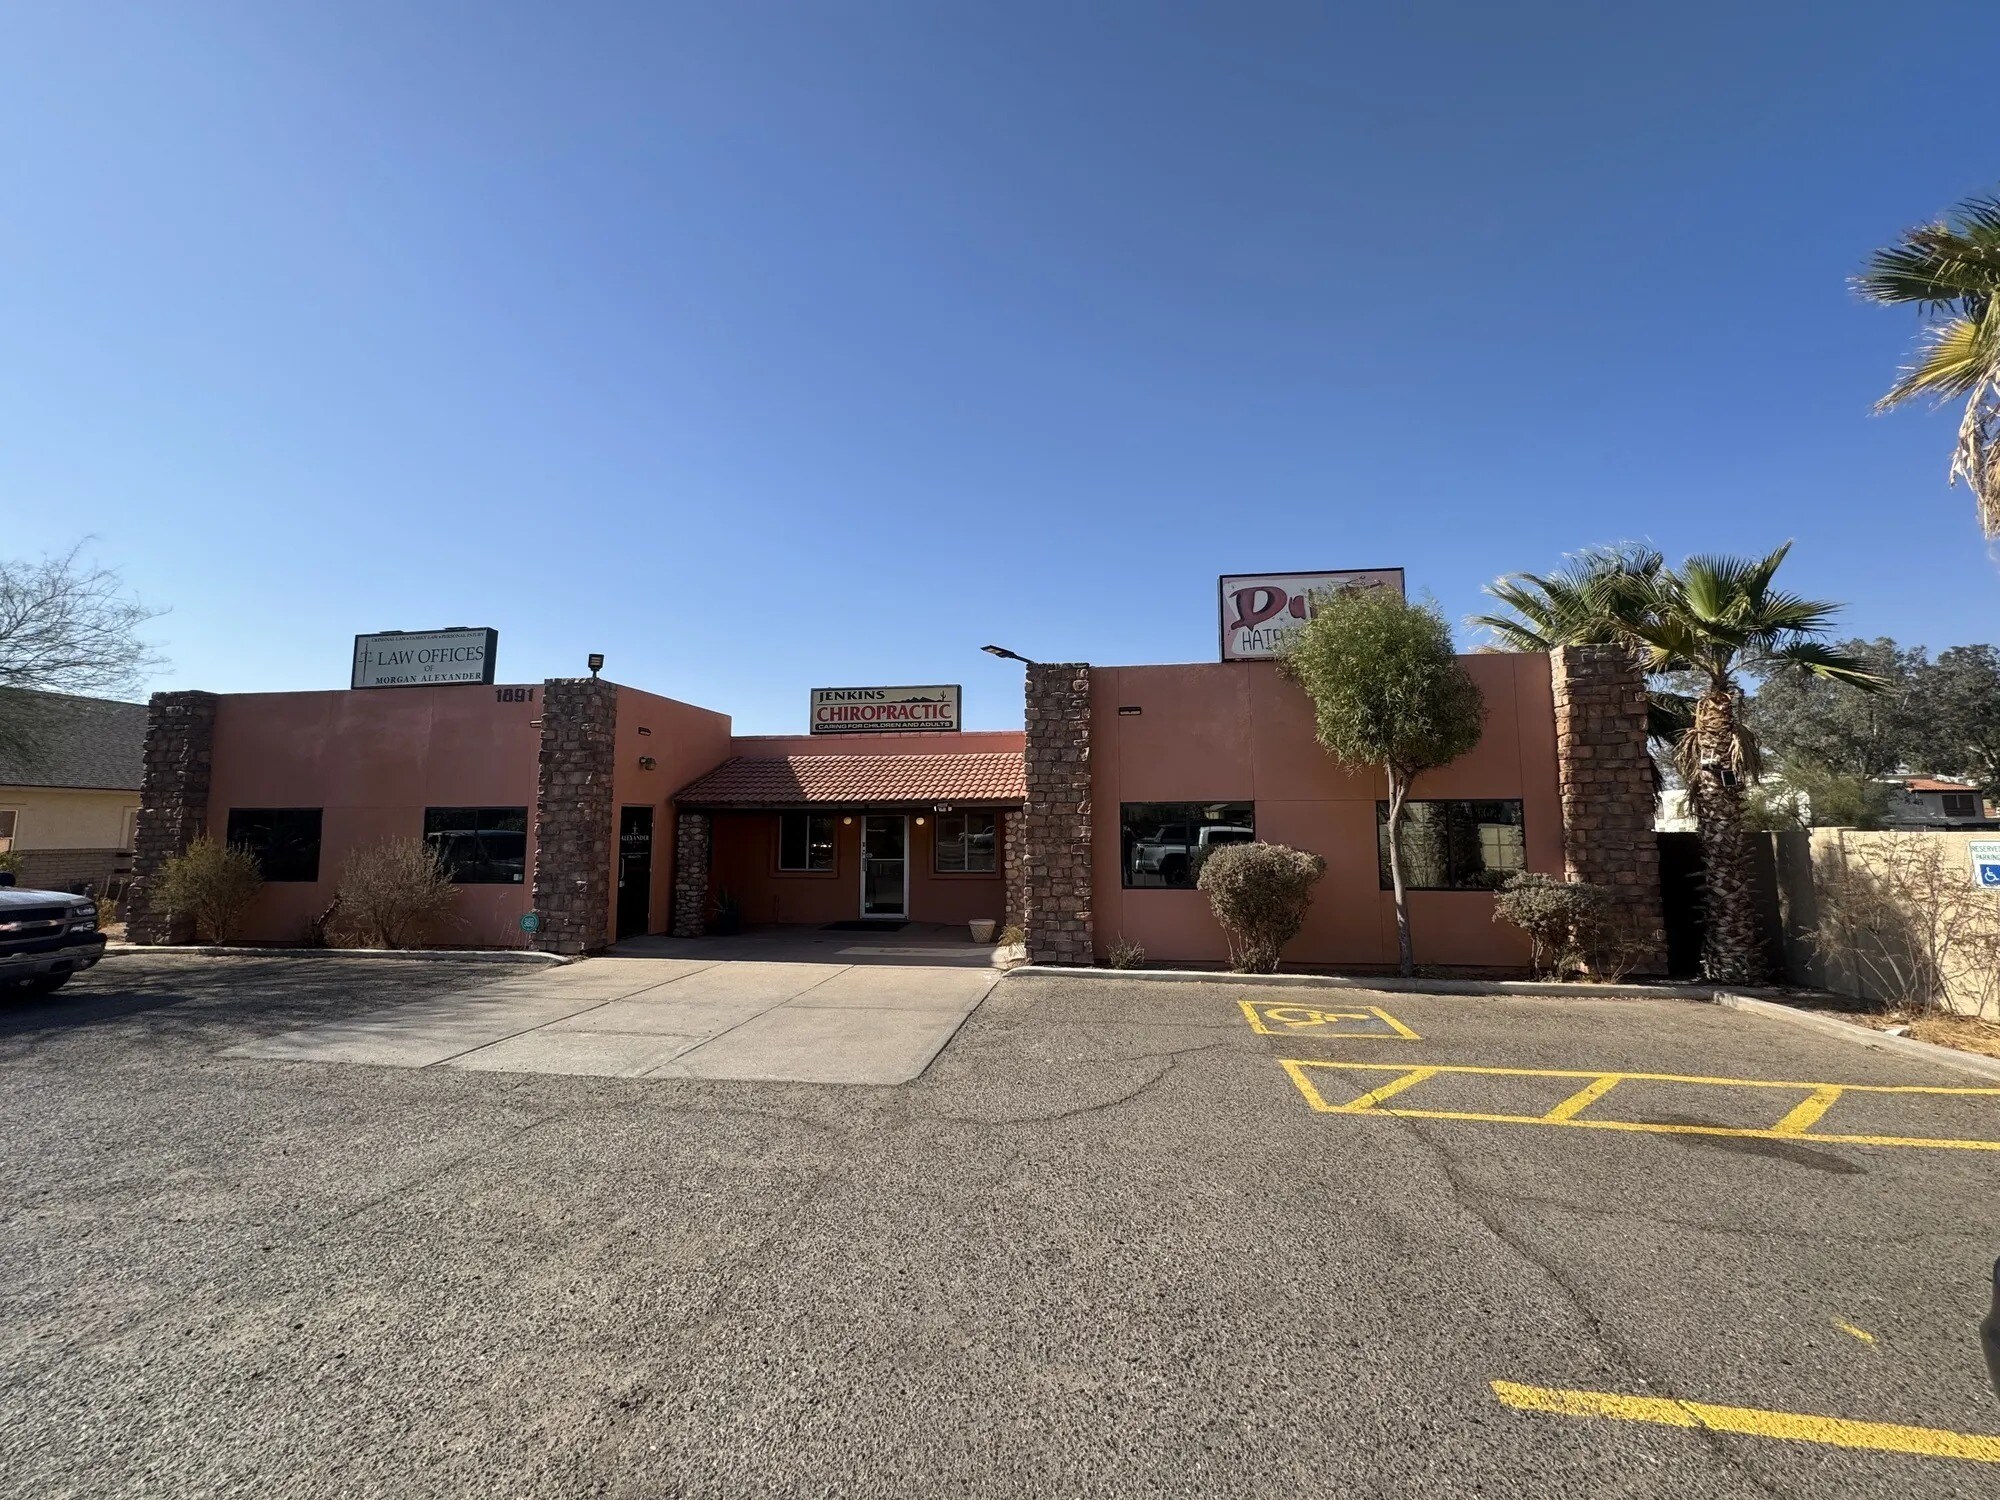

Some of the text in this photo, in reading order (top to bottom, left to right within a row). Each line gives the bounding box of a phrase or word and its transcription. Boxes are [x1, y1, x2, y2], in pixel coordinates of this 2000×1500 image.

[378, 646, 484, 666] LAW OFFICES
[424, 664, 434, 672] OF
[375, 672, 481, 684] MORGAN ALEXANDER
[496, 688, 534, 702] 1891
[819, 690, 885, 703] JENKINS
[817, 704, 952, 722] CHIROPRACTIC
